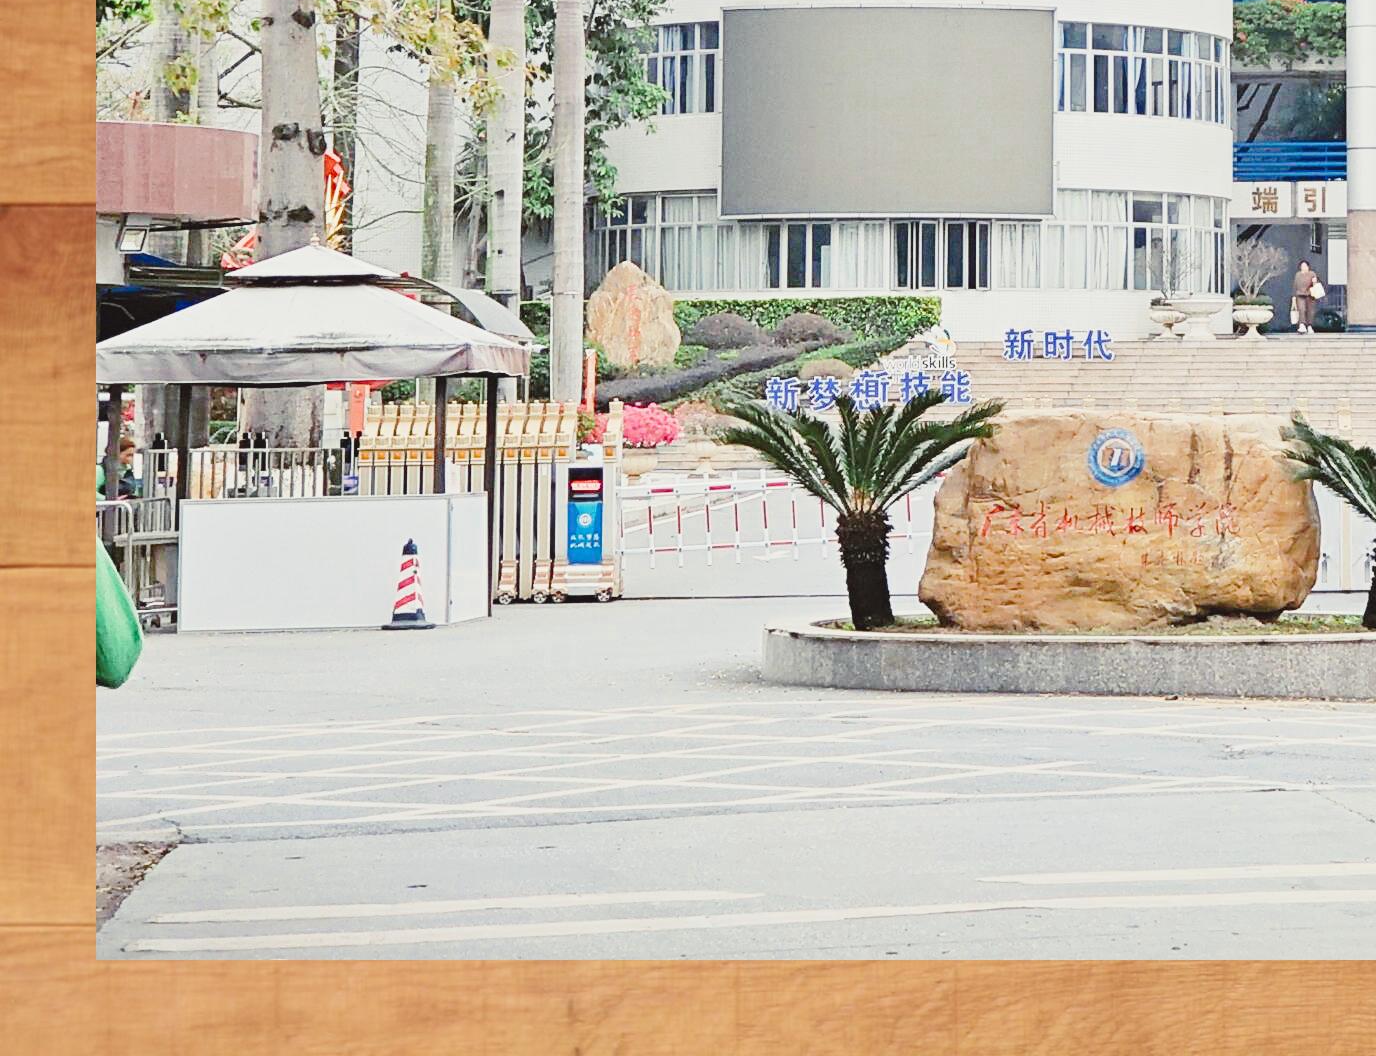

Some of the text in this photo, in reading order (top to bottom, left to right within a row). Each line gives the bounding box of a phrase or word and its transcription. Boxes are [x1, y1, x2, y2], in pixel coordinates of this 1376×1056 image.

[1251, 185, 1326, 215] 端引
[1004, 328, 1115, 361] 新时代
